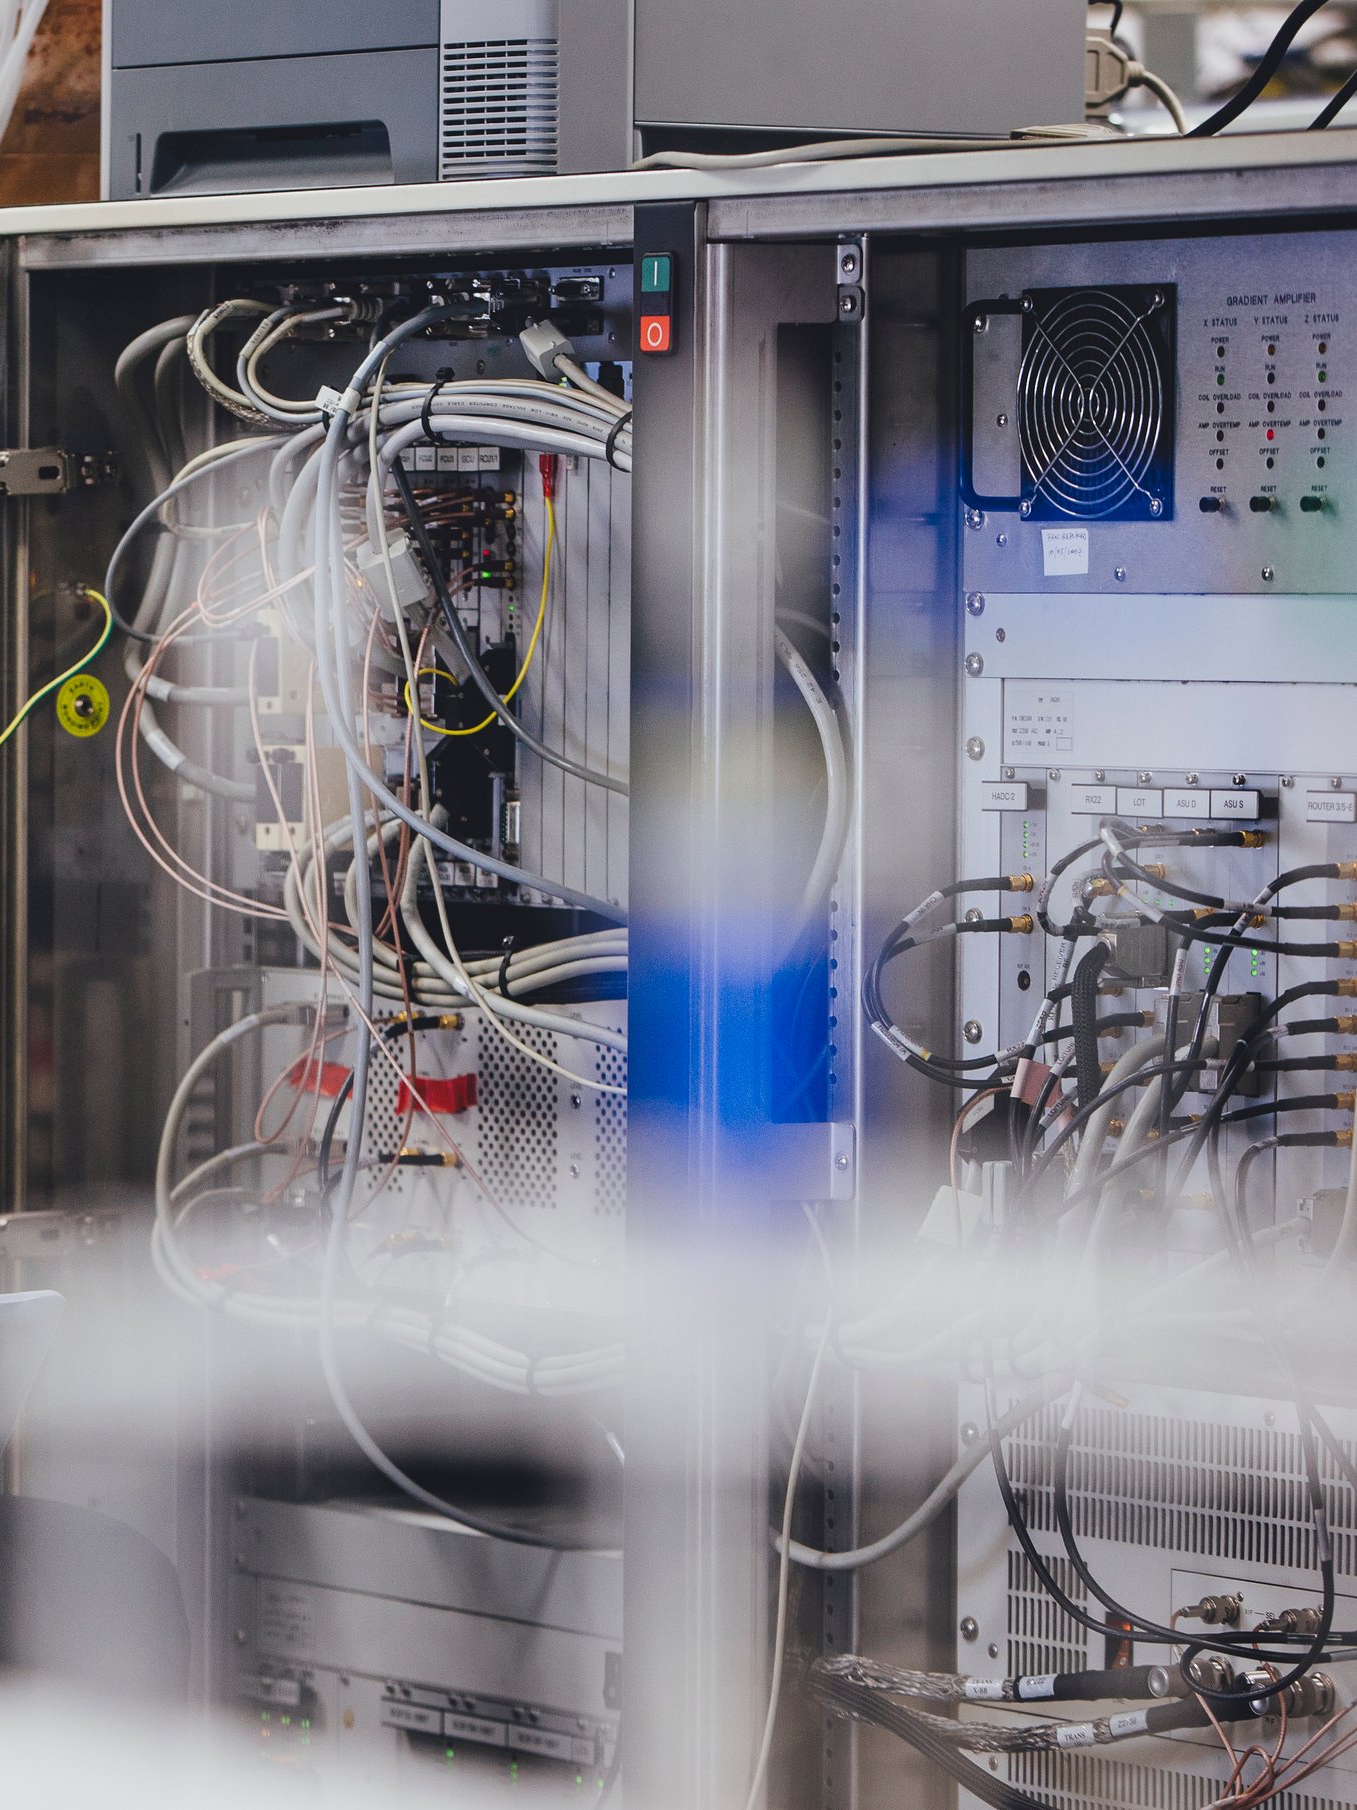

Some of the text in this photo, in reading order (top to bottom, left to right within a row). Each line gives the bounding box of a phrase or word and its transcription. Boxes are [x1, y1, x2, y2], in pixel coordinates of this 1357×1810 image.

[1226, 292, 1316, 306] GRADIENT AMPLIFIER
[1204, 318, 1238, 327] X STATUS
[1254, 316, 1288, 325] Y STATUS
[1304, 314, 1339, 323] Z STATUS
[1085, 795, 1101, 803] RX22
[1177, 800, 1196, 808] ASU D
[1224, 800, 1244, 808] ASU S
[1006, 1041, 1025, 1053] RX22
